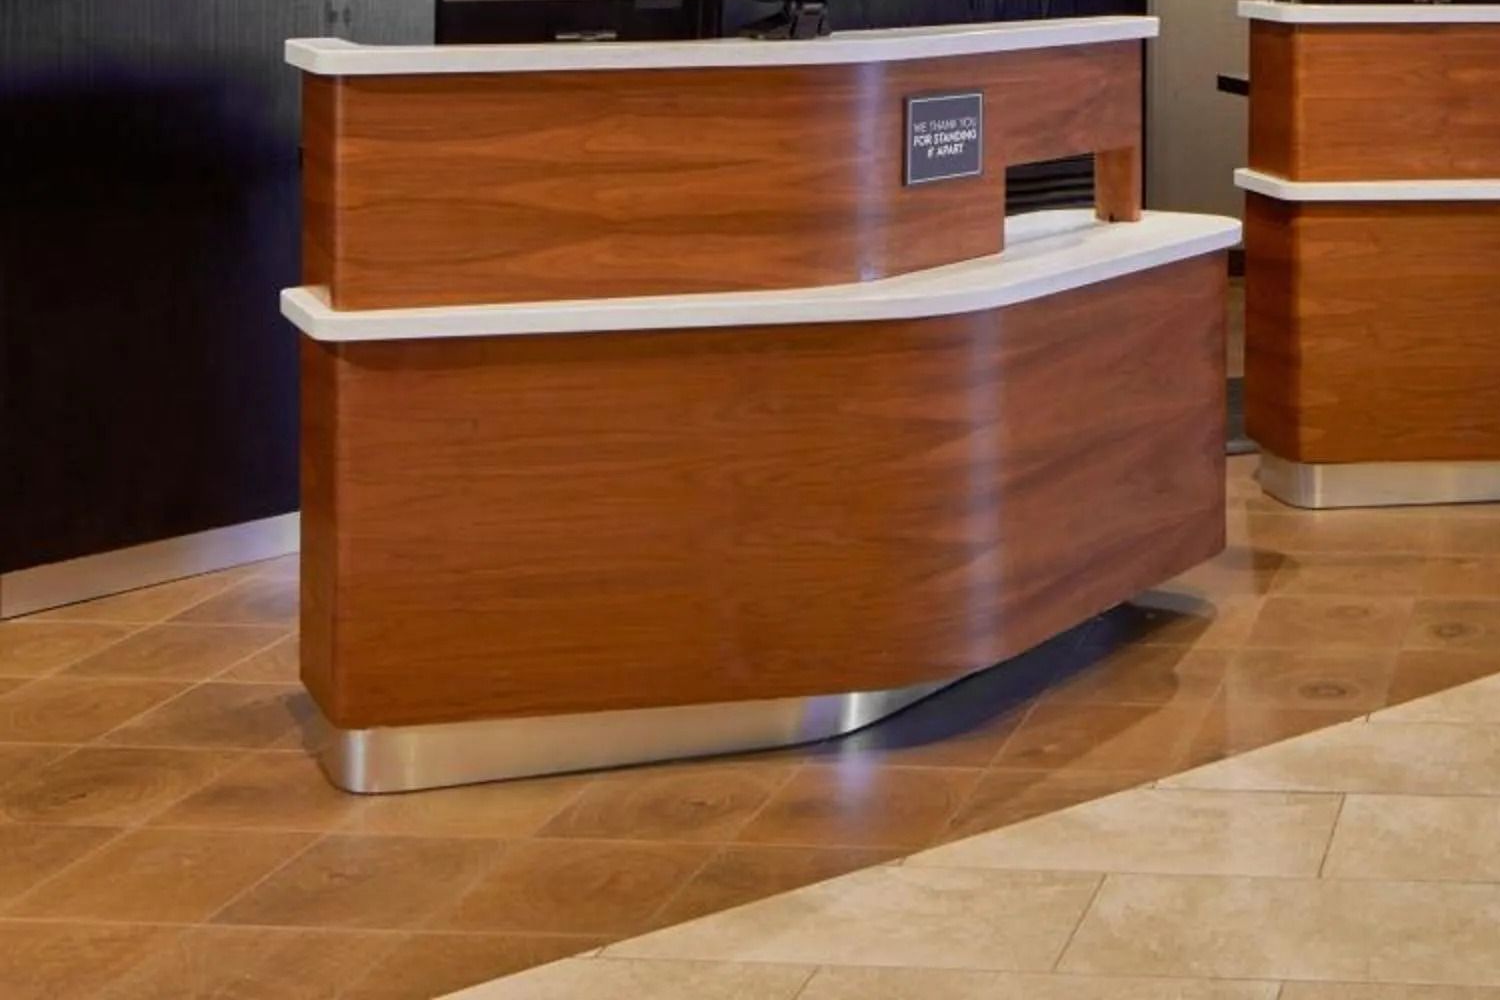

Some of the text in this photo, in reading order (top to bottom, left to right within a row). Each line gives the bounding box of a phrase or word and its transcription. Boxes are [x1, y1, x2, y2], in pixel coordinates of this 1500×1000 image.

[913, 129, 977, 147] FOR STANDING
[937, 143, 963, 156] APART
